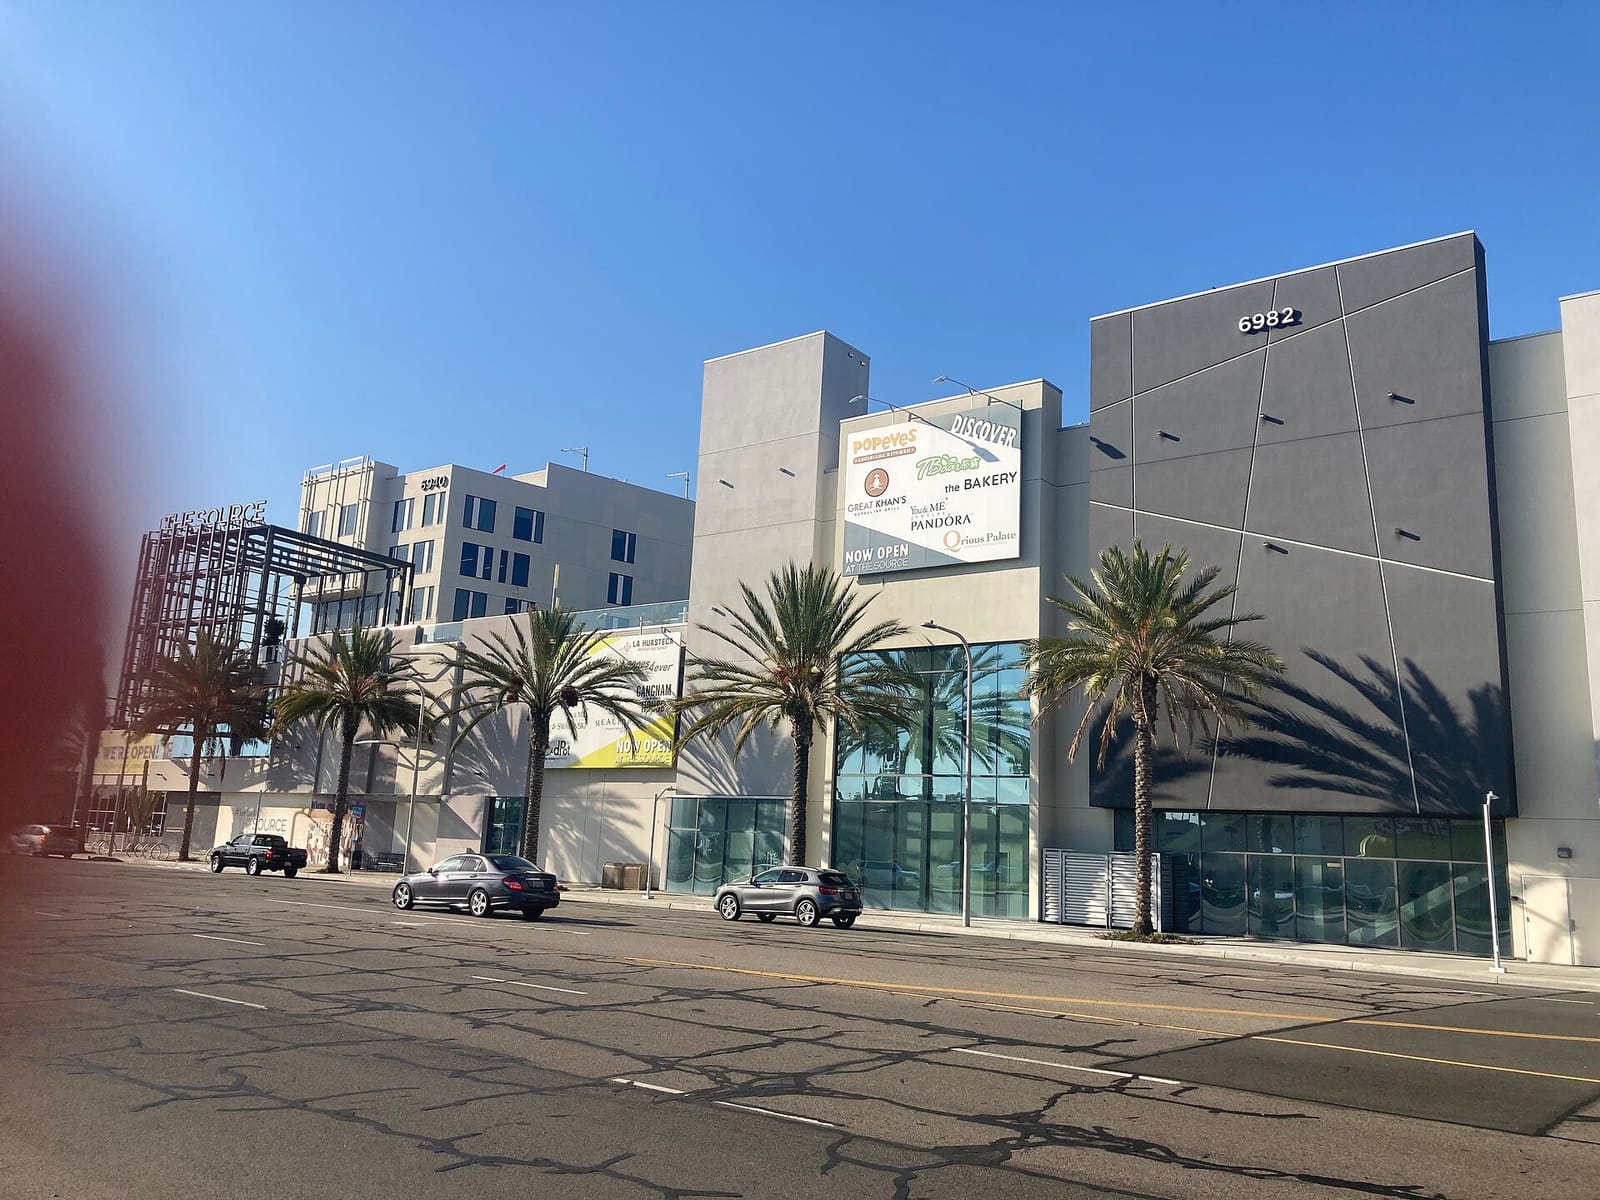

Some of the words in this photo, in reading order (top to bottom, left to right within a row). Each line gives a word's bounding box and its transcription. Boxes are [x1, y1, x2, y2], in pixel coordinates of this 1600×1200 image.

[1239, 307, 1294, 332] 6982
[950, 414, 1017, 448] DISCOVER
[945, 484, 960, 493] the
[964, 471, 1017, 490] BAKERY
[847, 501, 873, 513] GREAT
[875, 495, 907, 508] KHAN'S
[164, 511, 195, 529] THE
[196, 500, 267, 527] SOURCE
[911, 514, 971, 531] PANDORA
[943, 530, 985, 552] Qrious
[986, 530, 1017, 542] Palate
[845, 548, 873, 564] NOW
[877, 543, 909, 559] OPEN
[845, 564, 856, 574] AT
[857, 562, 873, 572] THE
[873, 557, 909, 570] SOURCE
[633, 640, 640, 648] LA
[642, 637, 673, 647] HUASTECA
[636, 683, 672, 697] GANGNAM
[643, 740, 672, 754] OPEN
